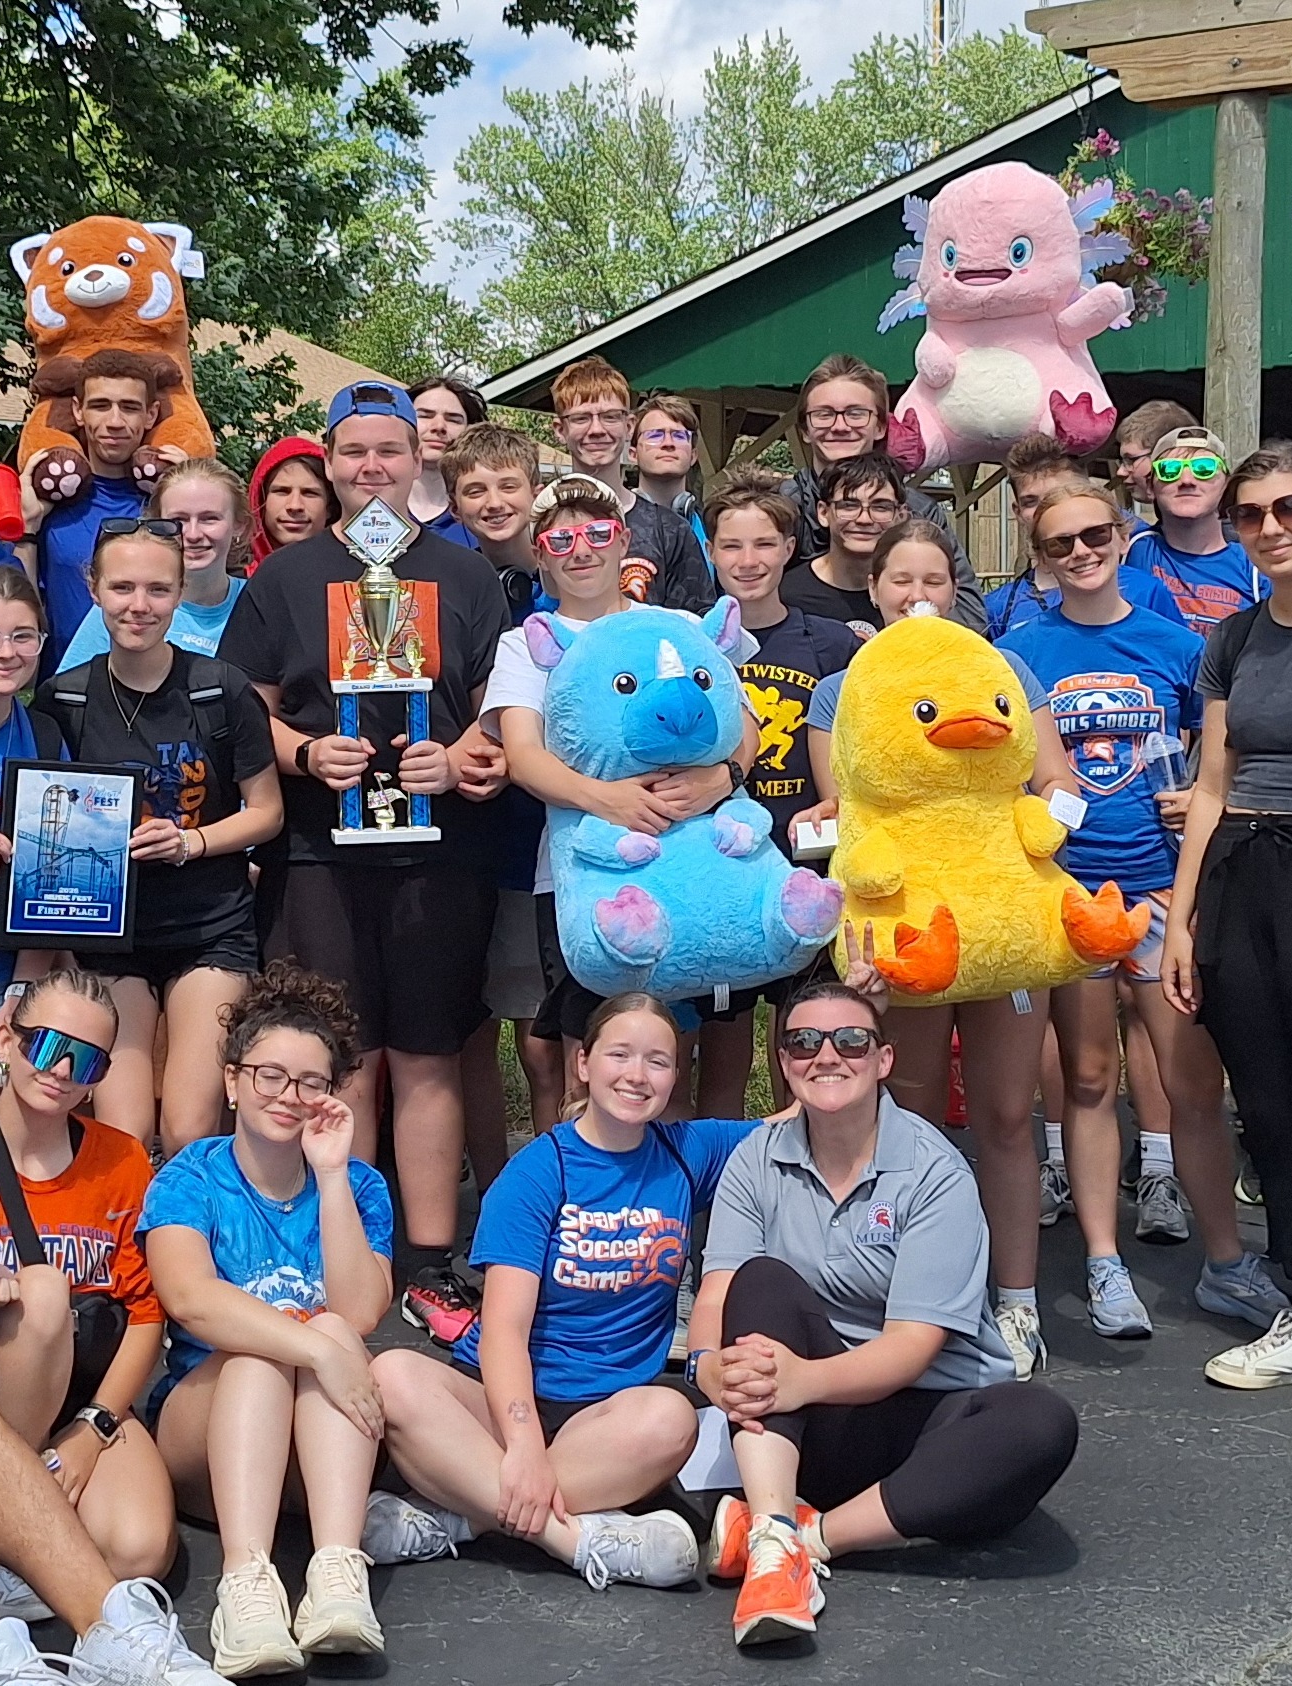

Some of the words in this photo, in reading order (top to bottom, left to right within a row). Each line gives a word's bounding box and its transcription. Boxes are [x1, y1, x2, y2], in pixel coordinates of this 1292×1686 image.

[738, 663, 819, 692] TWISTED
[1094, 712, 1160, 730] SOCCER
[93, 796, 120, 808] FEST
[755, 779, 806, 797] MEET
[559, 1203, 661, 1235] Spartan
[558, 1230, 654, 1262] Soccer
[552, 1257, 634, 1294] Camp
